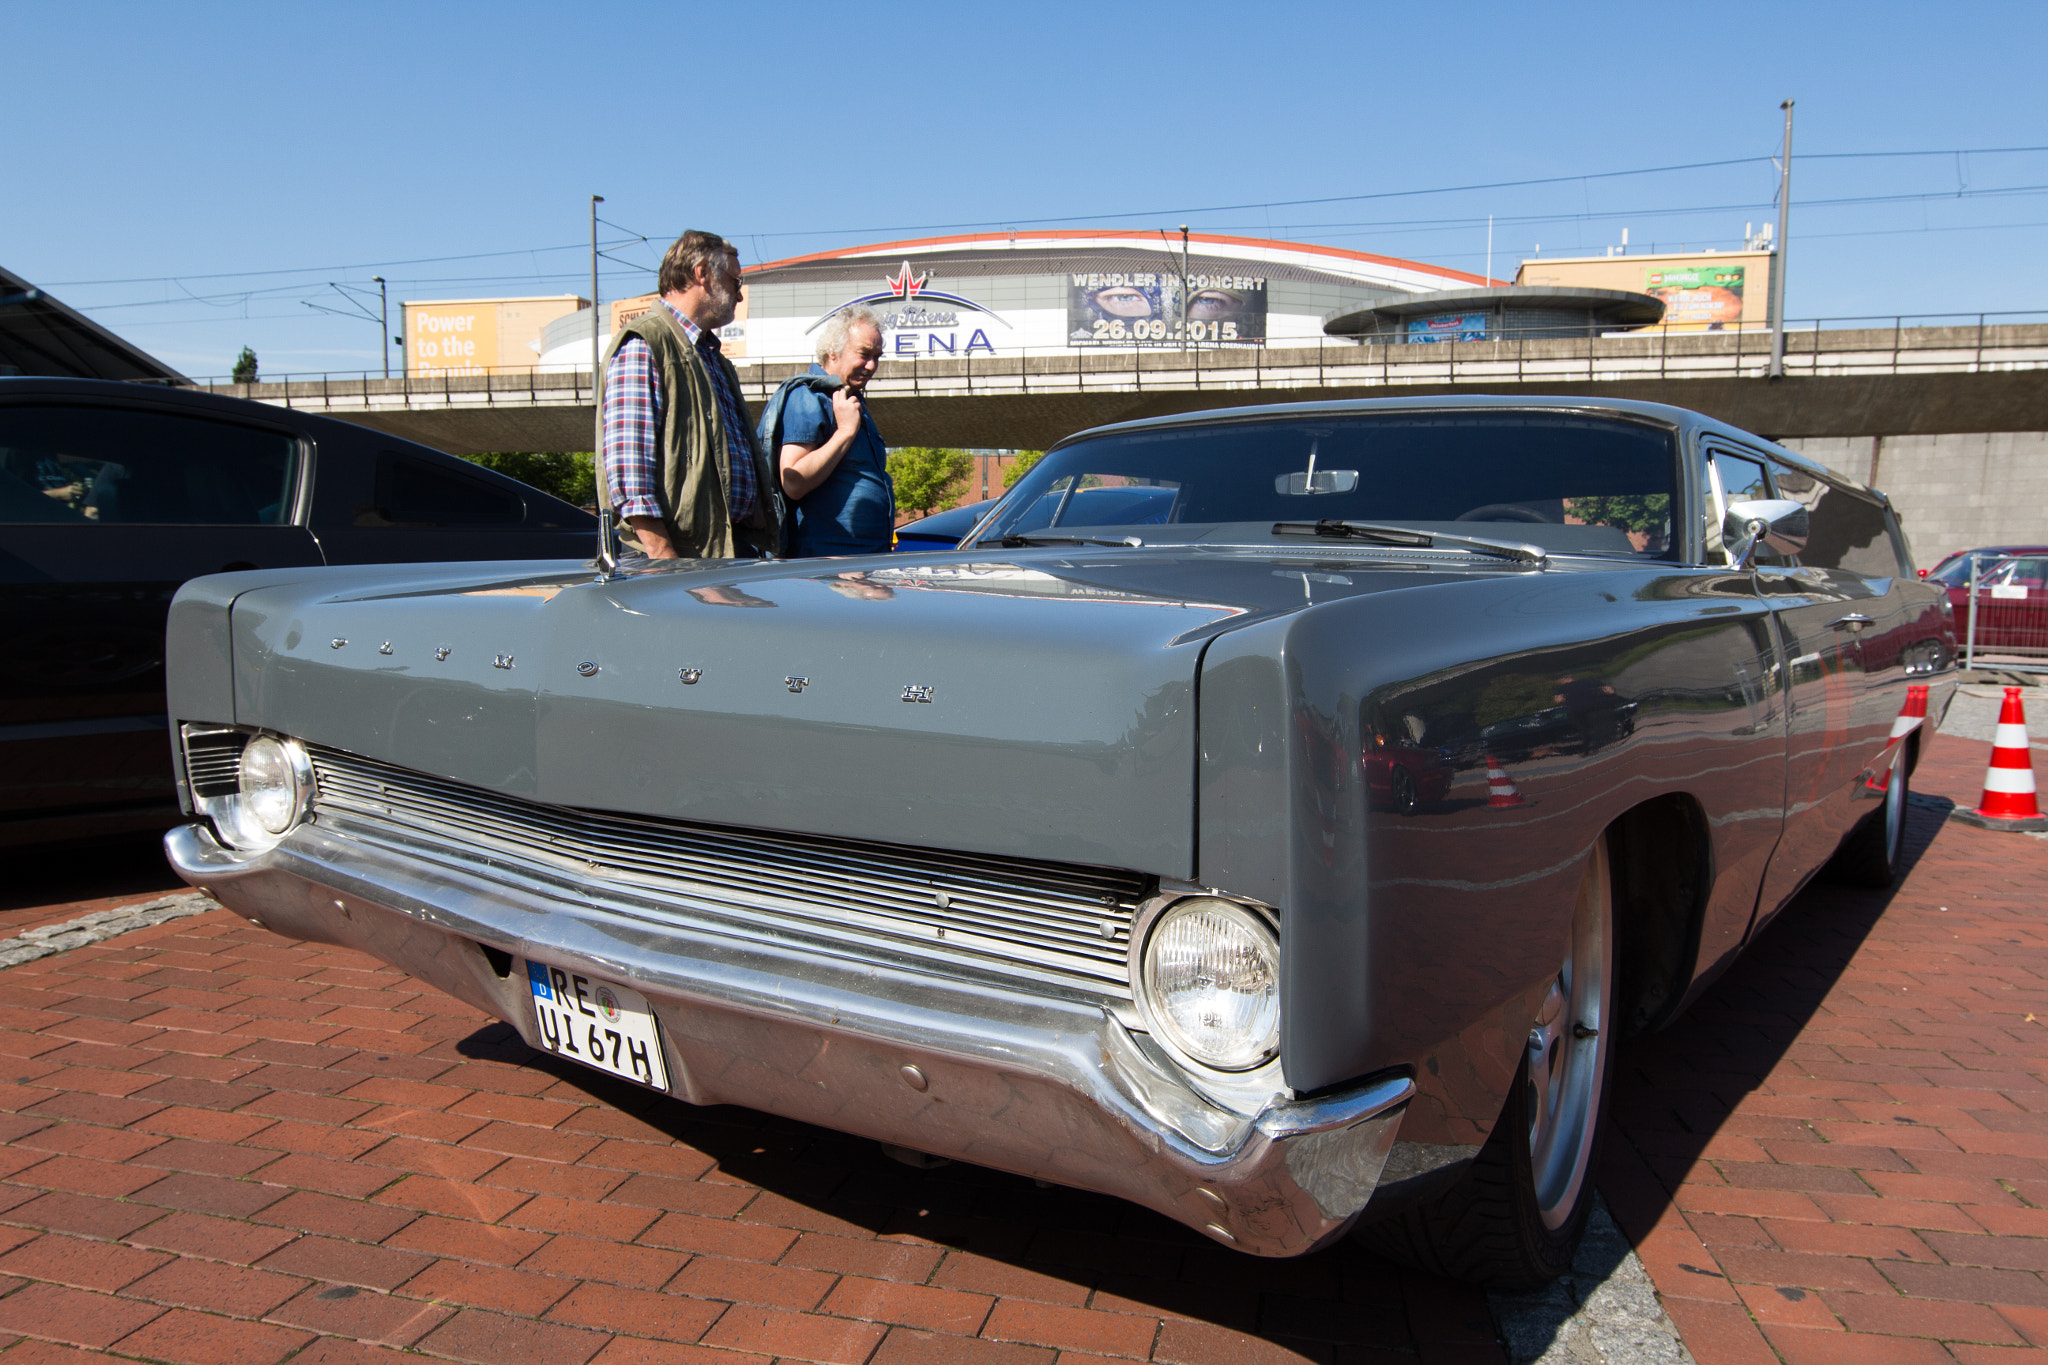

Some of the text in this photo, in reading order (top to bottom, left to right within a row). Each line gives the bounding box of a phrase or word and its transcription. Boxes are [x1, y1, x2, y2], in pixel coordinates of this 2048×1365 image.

[1072, 273, 1264, 290] WENDLER IN CONCERT
[417, 312, 475, 333] Power
[899, 304, 959, 328] Pilsener
[1093, 319, 1239, 341] 26.09.2015
[416, 335, 475, 357] to the
[550, 966, 596, 1018] RE
[588, 1023, 653, 1085] 67H
